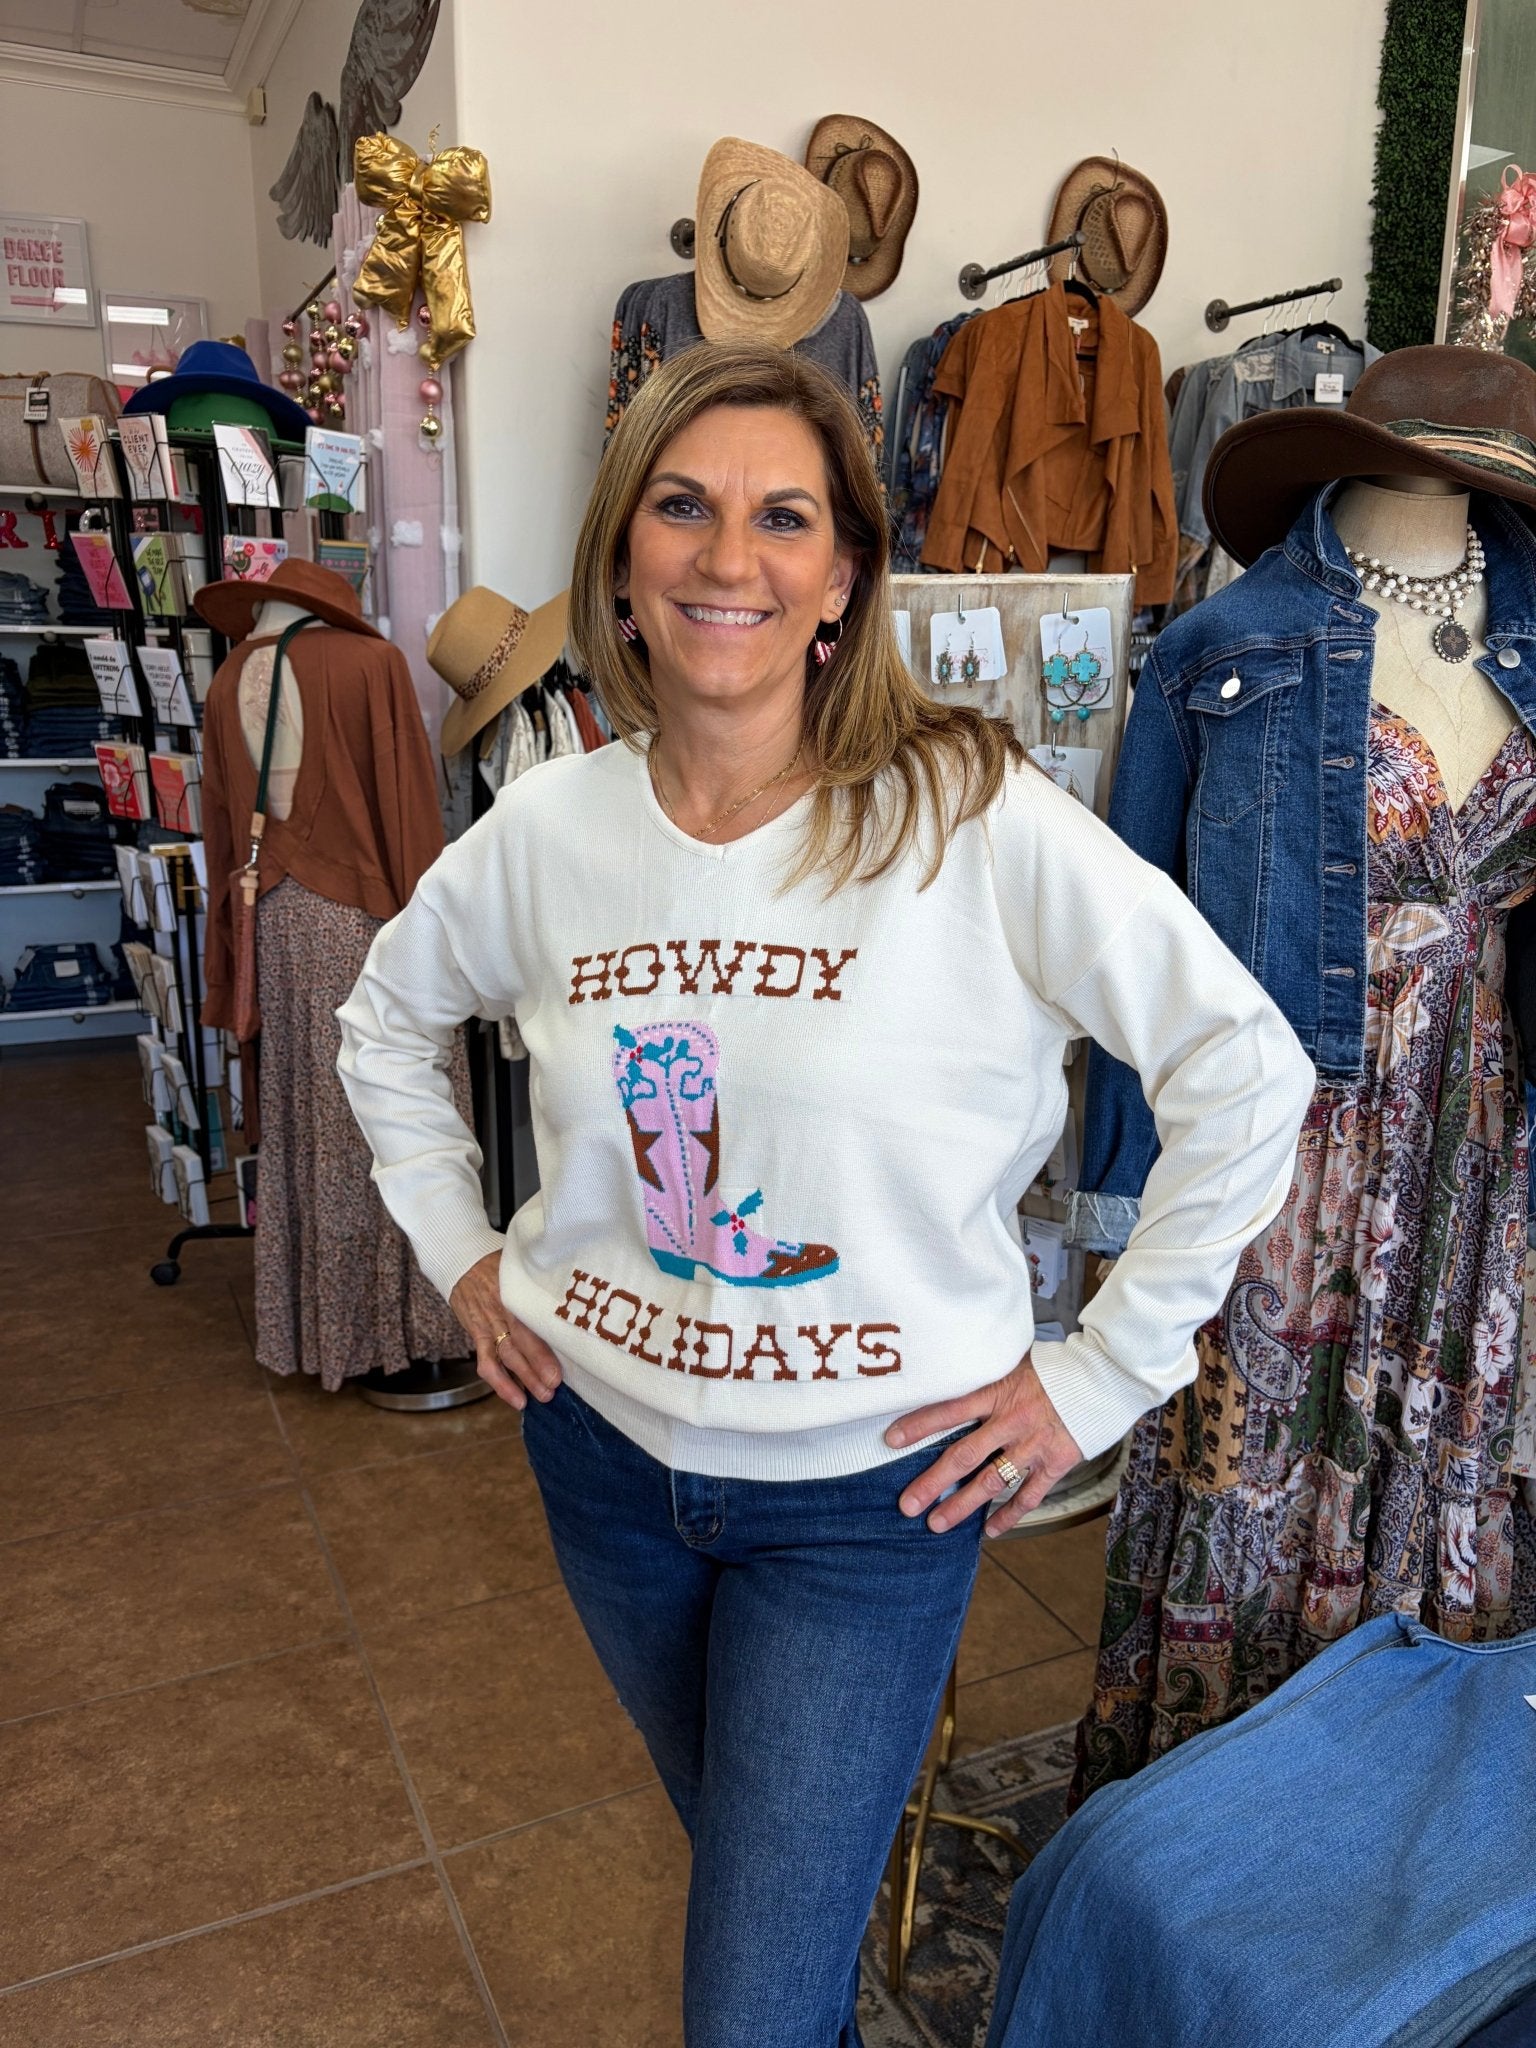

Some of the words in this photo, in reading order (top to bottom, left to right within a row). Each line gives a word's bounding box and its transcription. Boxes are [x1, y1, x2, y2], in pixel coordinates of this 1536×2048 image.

[4, 237, 64, 263] DANCE
[8, 264, 65, 288] FLOOR
[123, 434, 149, 444] CLIENT
[128, 444, 147, 454] EVER
[568, 940, 858, 1004] HOWDY
[555, 1269, 902, 1381] HOLIDAYS
